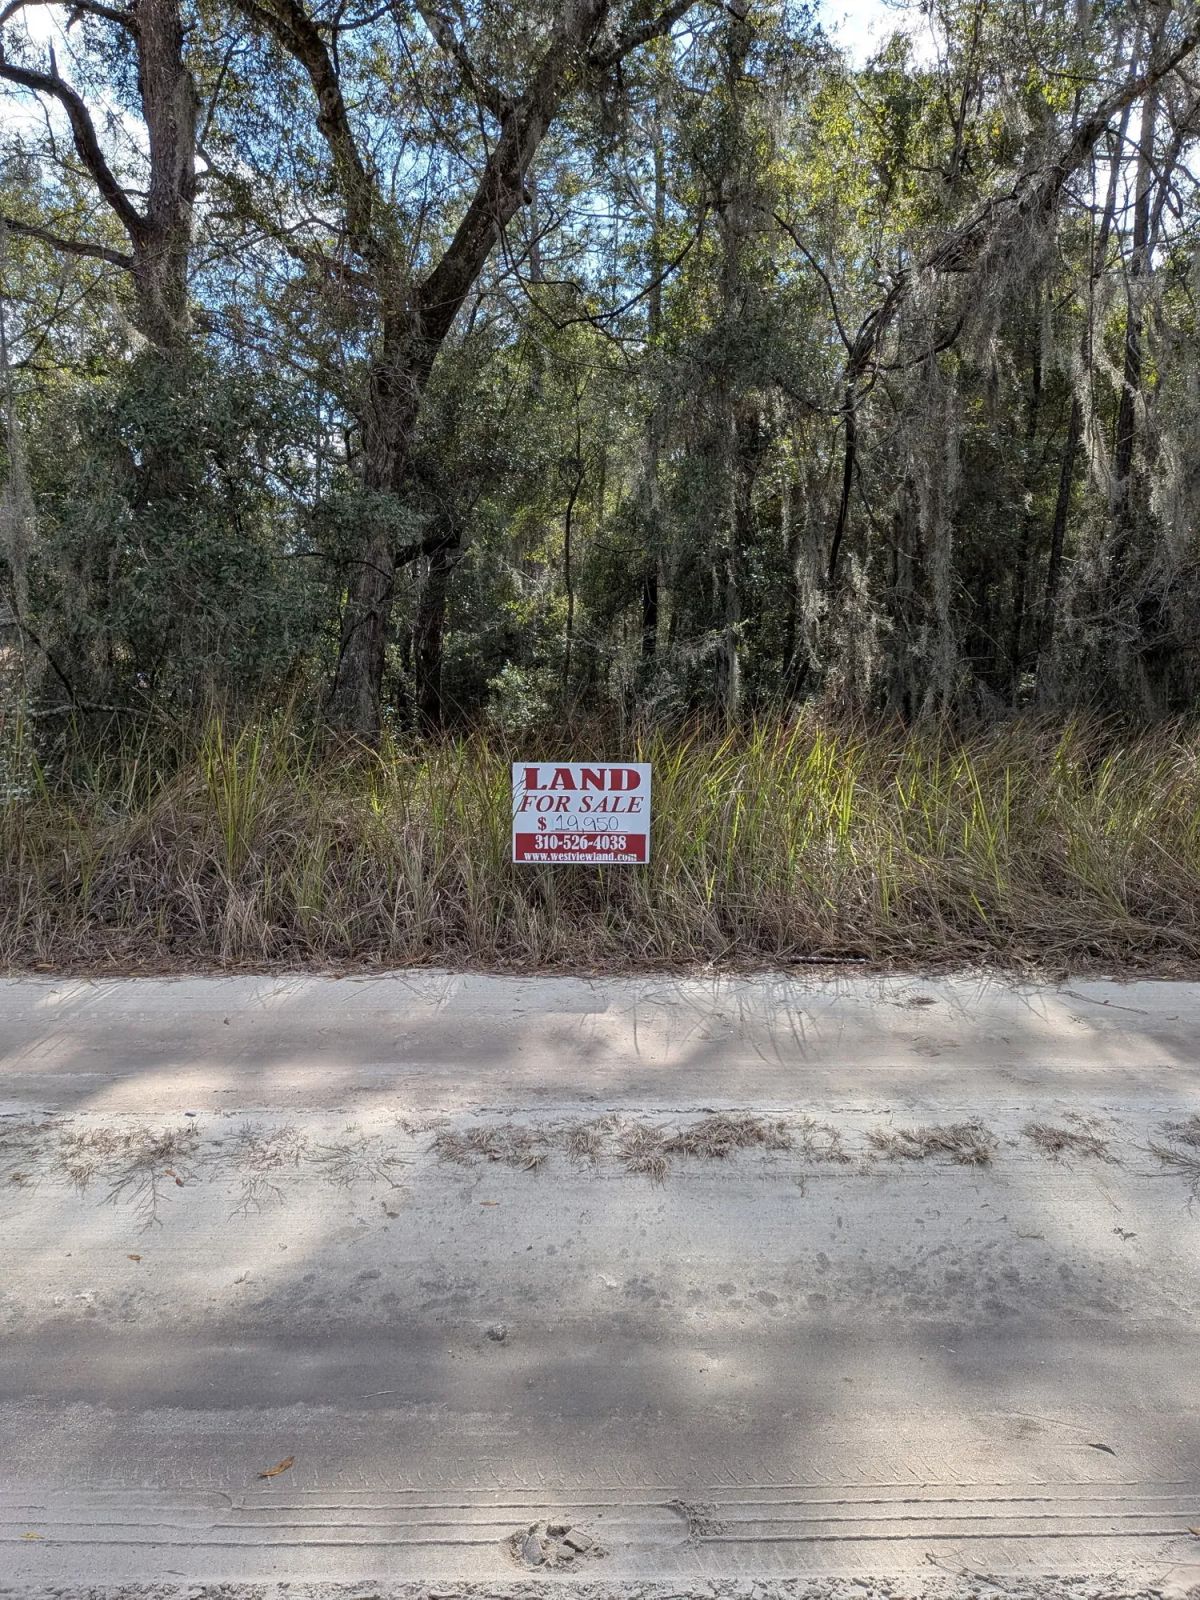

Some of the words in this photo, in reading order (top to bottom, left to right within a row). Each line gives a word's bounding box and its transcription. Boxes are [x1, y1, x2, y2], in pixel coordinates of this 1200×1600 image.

[523, 768, 641, 791] LAND
[519, 795, 571, 812] FOR
[579, 796, 644, 813] SALE
[537, 816, 547, 831] $
[535, 835, 626, 850] 310-526-4038
[524, 852, 637, 862] www.westviewland.com
